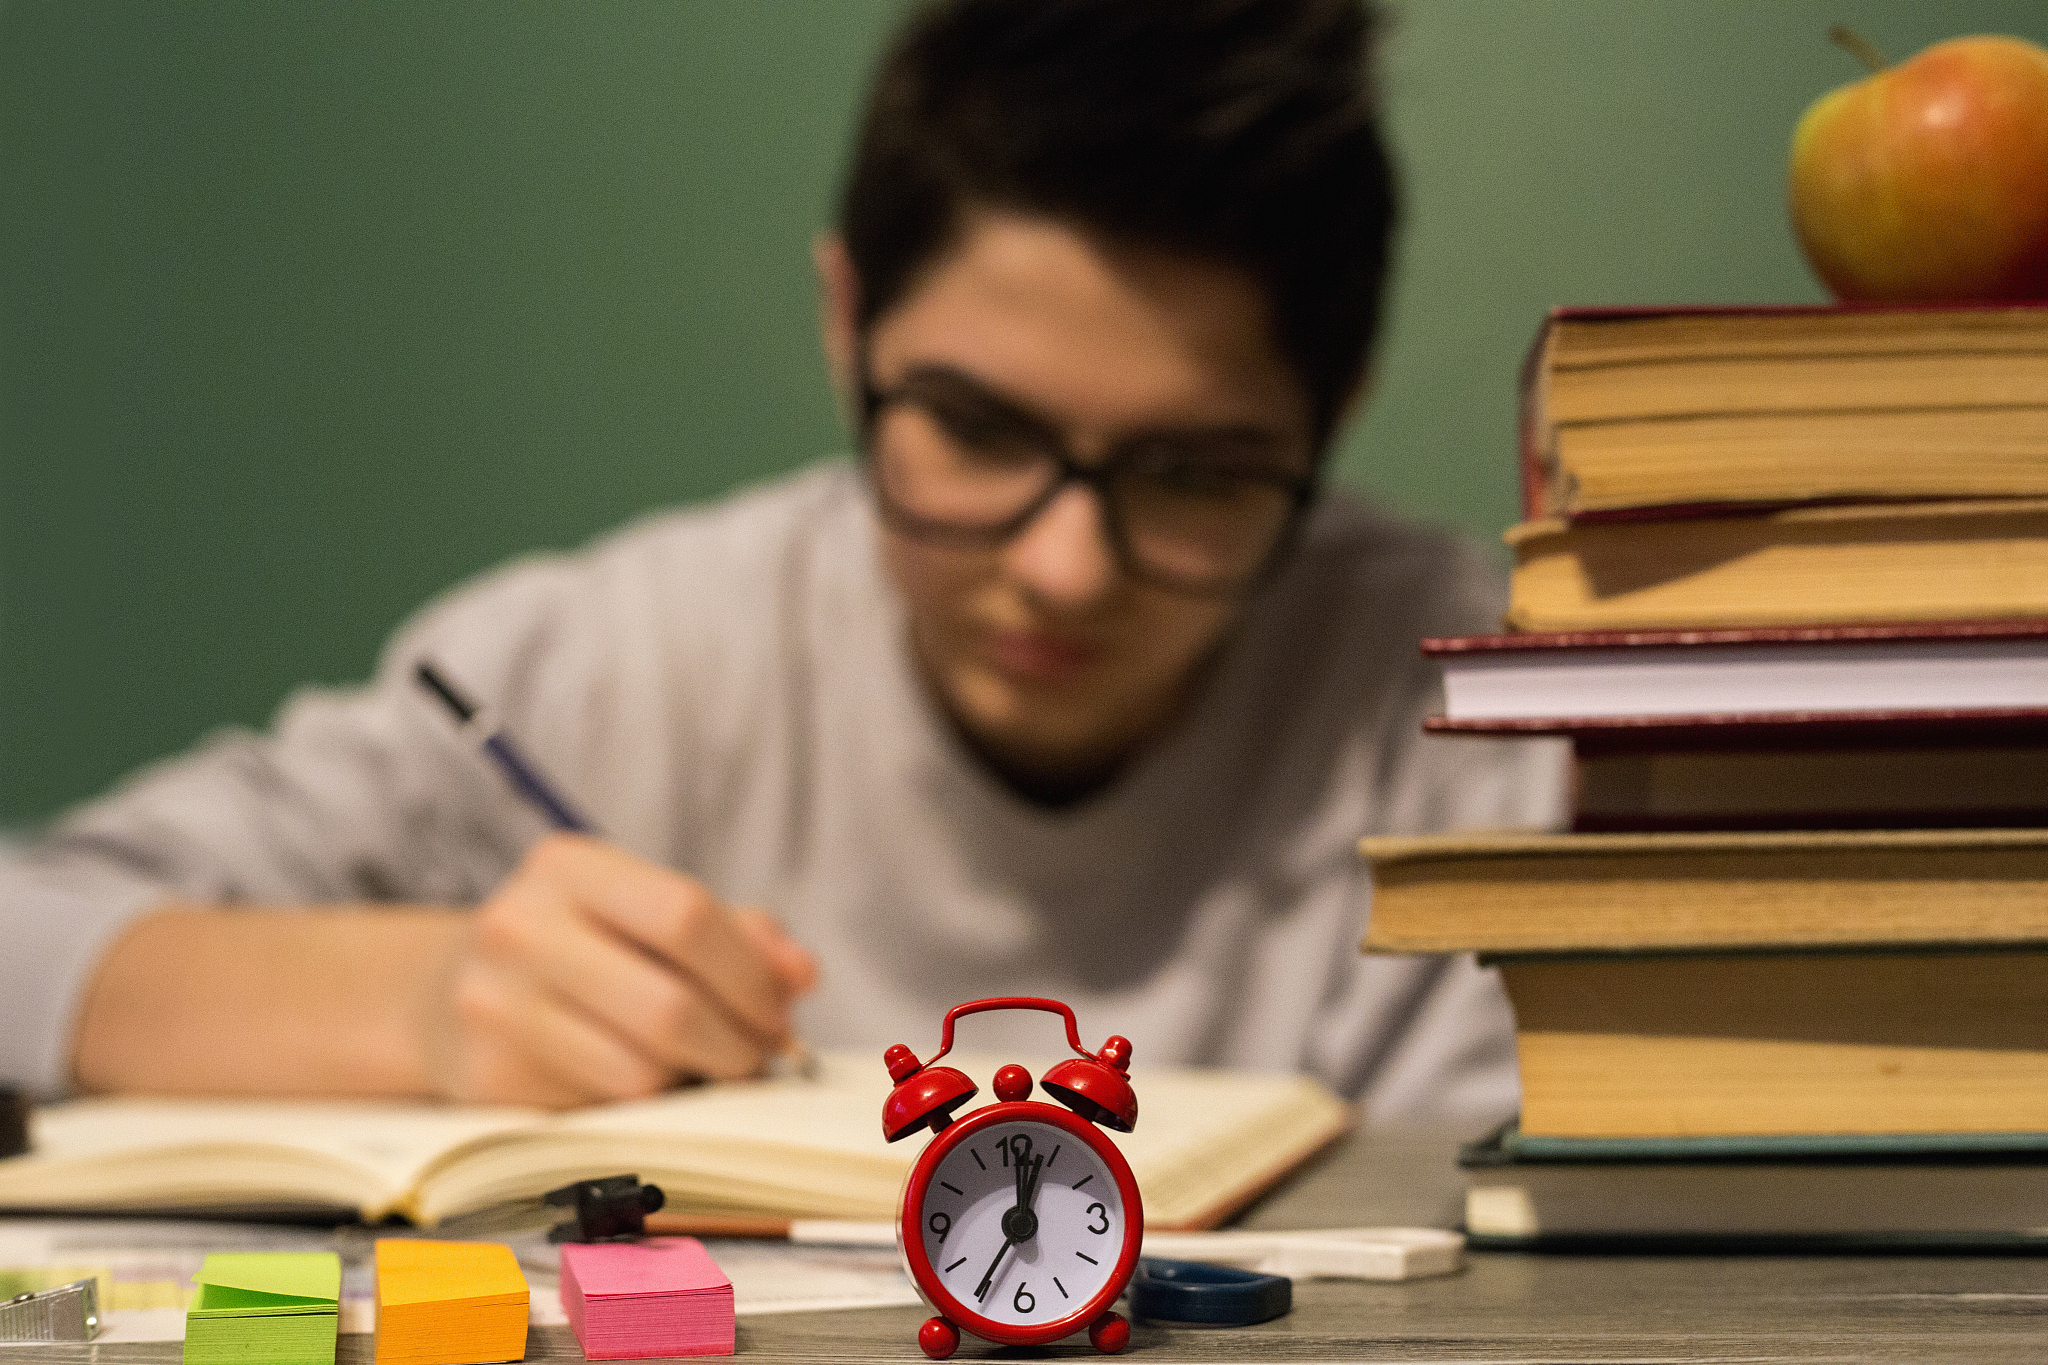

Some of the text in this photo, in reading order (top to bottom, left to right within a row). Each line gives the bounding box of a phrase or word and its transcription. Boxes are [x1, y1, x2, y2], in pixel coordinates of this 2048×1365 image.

[995, 1134, 1033, 1167] 12
[929, 1212, 951, 1244] 9
[1086, 1202, 1110, 1235] 3
[1013, 1281, 1036, 1314] 6
